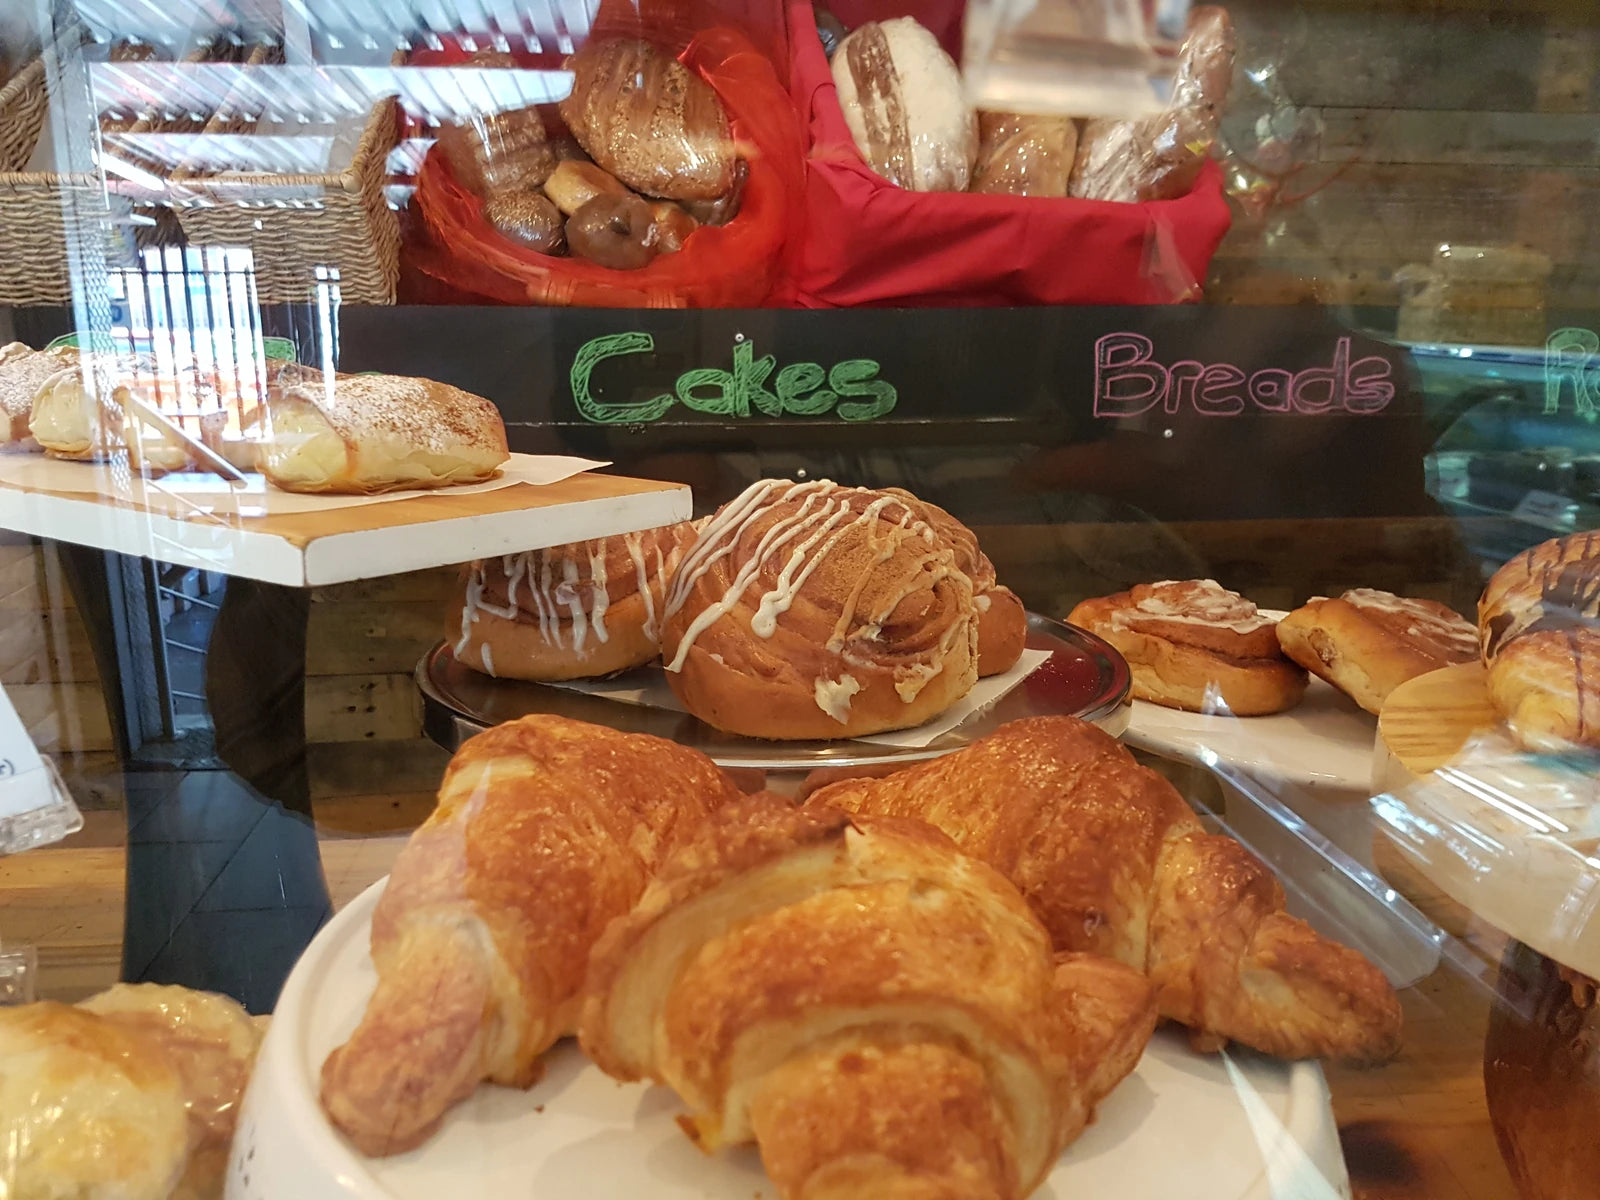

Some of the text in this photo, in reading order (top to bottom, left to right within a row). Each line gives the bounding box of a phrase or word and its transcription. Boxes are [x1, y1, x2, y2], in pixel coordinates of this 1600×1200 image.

[571, 332, 897, 422] Cakes
[1094, 332, 1395, 417] Breads
[1543, 327, 1600, 422] R
